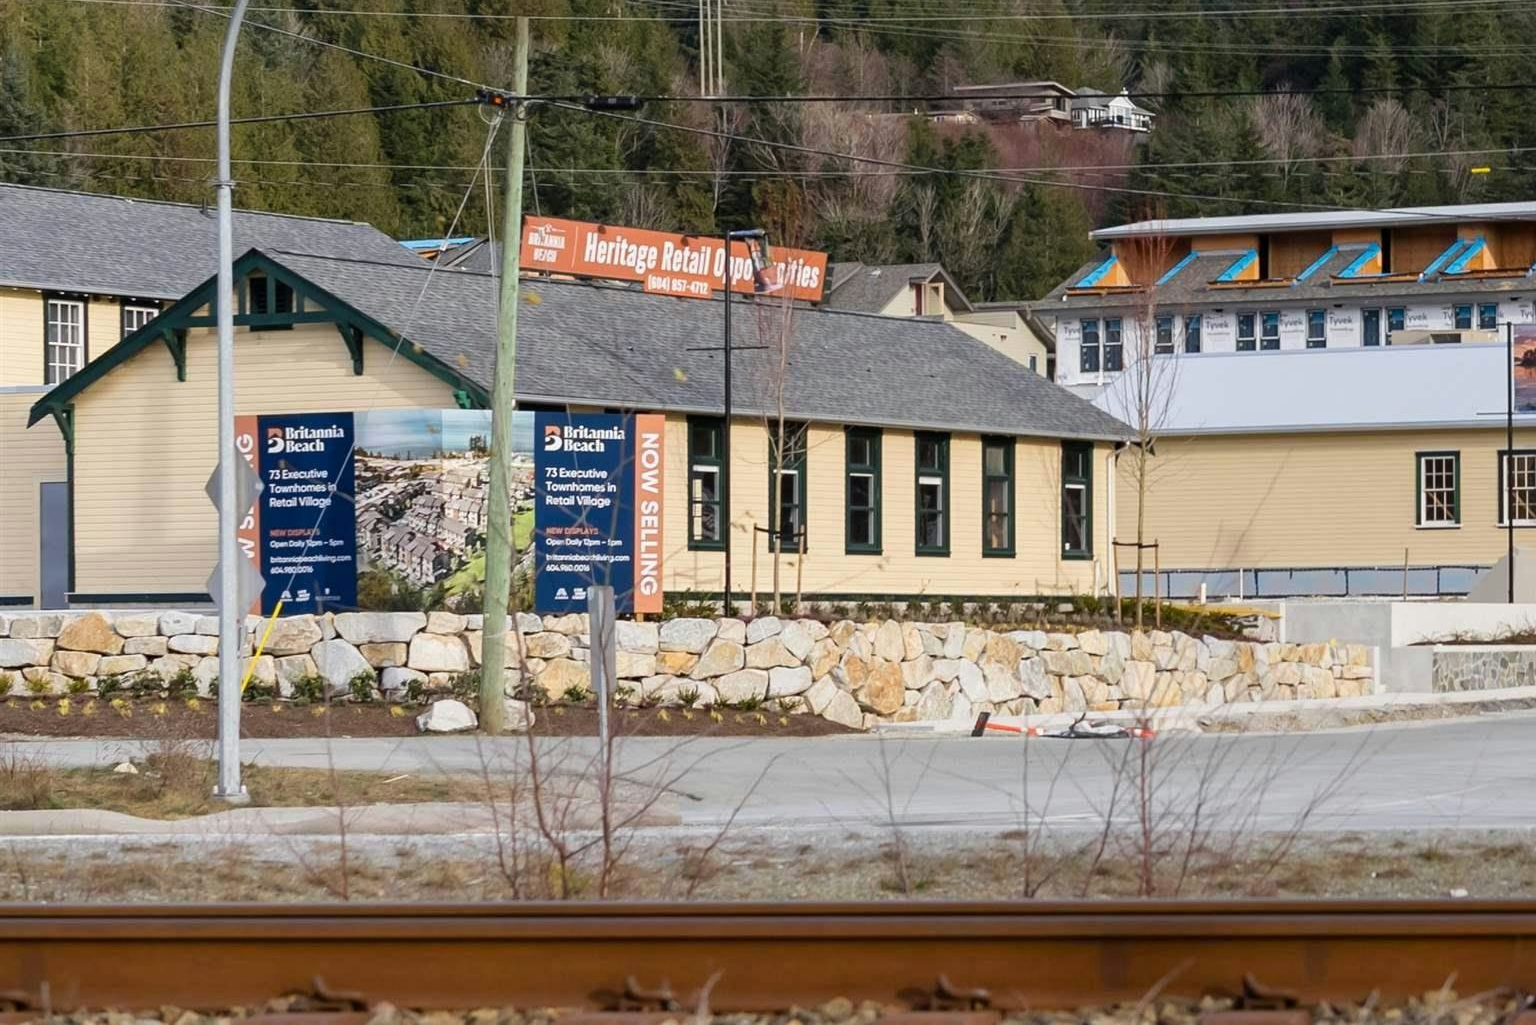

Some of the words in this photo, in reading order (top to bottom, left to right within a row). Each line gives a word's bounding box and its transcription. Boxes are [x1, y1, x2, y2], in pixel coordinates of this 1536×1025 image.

[584, 232, 658, 274] Heritage
[661, 241, 711, 275] Retail
[648, 274, 670, 292] (604)
[1329, 316, 1353, 326] Tyvek
[285, 425, 344, 440] Britannia
[563, 425, 625, 440] Britannia
[285, 439, 325, 453] Beach
[563, 438, 605, 452] Beach
[641, 433, 660, 494] NOW
[268, 469, 280, 480] 73
[282, 469, 328, 480] Executive
[545, 467, 557, 478] 73
[559, 467, 608, 479] Executive
[269, 483, 326, 493] Townhomes
[328, 482, 337, 492] in
[545, 481, 605, 492] Townhomes
[607, 482, 617, 492] in
[269, 497, 297, 507] Retail
[299, 496, 332, 508] Village
[545, 495, 575, 505] Retail
[576, 496, 612, 508] Village
[270, 540, 288, 548] Open
[289, 540, 305, 548] Daily
[329, 538, 344, 546] 5pm
[546, 538, 564, 546] Open
[565, 538, 582, 546] Daily
[583, 538, 601, 546] 12pm
[640, 501, 659, 596] SELLING
[270, 555, 352, 563] britanniabeachliving.com
